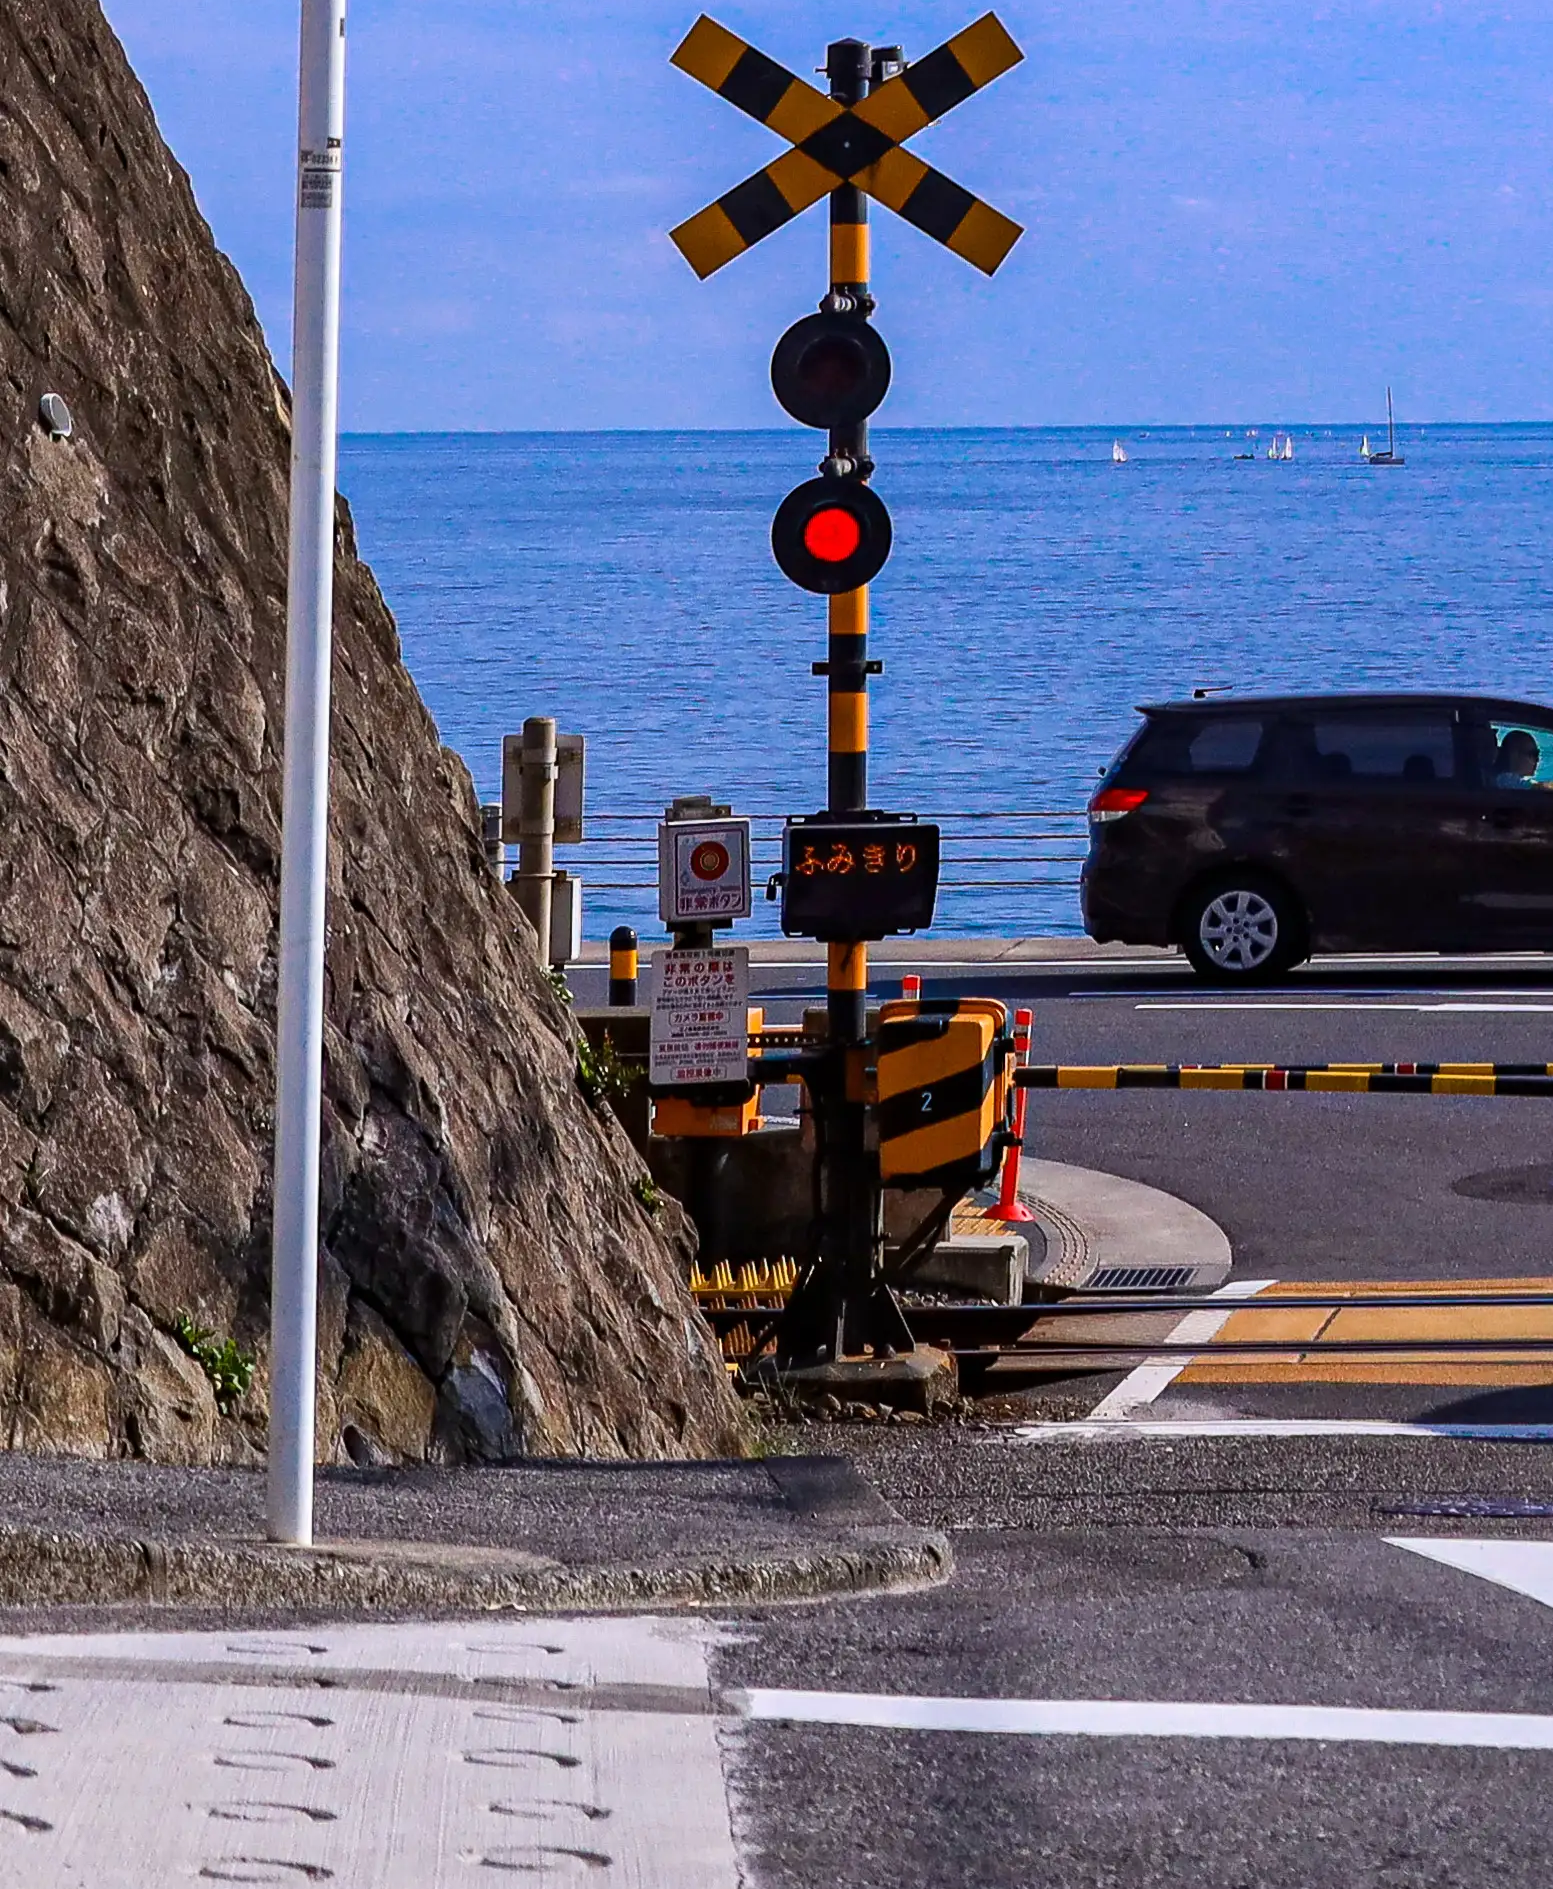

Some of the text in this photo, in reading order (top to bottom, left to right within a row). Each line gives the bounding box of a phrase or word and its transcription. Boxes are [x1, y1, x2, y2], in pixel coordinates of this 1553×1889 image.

[796, 843, 917, 875] ふみきり
[680, 891, 742, 910] 非常ボタン
[664, 960, 734, 975] 非常の際は
[663, 974, 734, 987] このボタンを
[921, 1092, 932, 1112] 2
